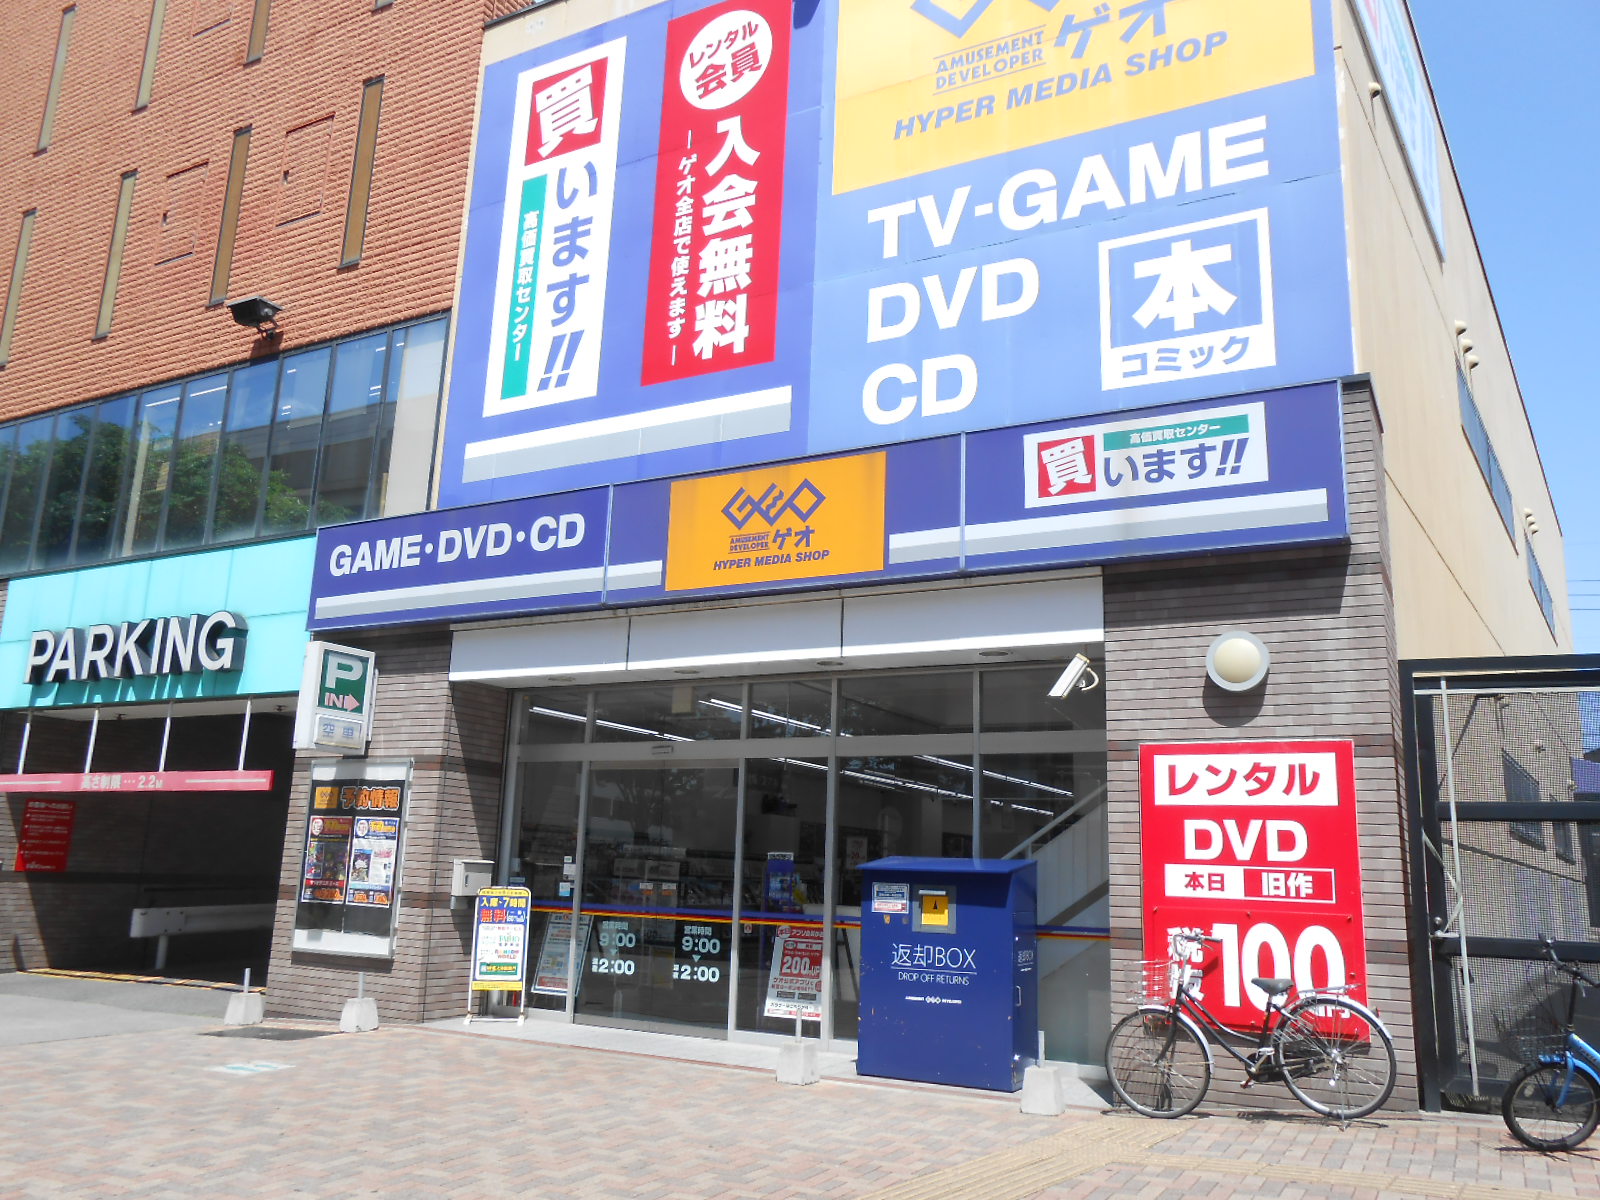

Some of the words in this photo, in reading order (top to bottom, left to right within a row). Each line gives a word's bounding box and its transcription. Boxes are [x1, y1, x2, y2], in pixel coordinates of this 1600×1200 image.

[687, 20, 760, 68] レンタル
[1053, 0, 1172, 59] ゲオ
[694, 42, 764, 101] 会員
[935, 29, 1046, 74] AMUSEMENT
[935, 48, 1044, 90] DEVELOPER
[893, 94, 996, 141] HYPER
[1006, 61, 1113, 111] MEDIA
[1124, 30, 1228, 77] SHOP
[867, 115, 1270, 260] TV-GAME
[667, 152, 698, 340] ゲオ全店で使えます
[692, 115, 762, 361] 入会無料
[511, 209, 541, 362] 高価買取センター
[866, 256, 1040, 344] DVD
[1132, 239, 1237, 332] 本
[1121, 335, 1251, 379] コミック
[861, 353, 978, 426] CD
[1129, 423, 1222, 445] 高価買取センター
[729, 532, 770, 545] AMUSEMENT
[729, 540, 770, 552] DEVELOPER
[772, 525, 816, 551] ゲオ
[713, 556, 752, 571] HYPER
[754, 553, 793, 568] MEDIA
[795, 549, 831, 563] SHOP
[23, 610, 246, 685] PARKING
[324, 655, 364, 690] P
[324, 692, 344, 709] IN
[1167, 761, 1321, 797] レンタル
[1183, 819, 1308, 862] DVD
[1184, 872, 1225, 892] 本日
[1261, 872, 1313, 898] 旧作
[599, 932, 636, 948] 9:00
[681, 936, 721, 954] 9:00
[890, 943, 977, 969] 返却BOX
[898, 971, 919, 983] DROP
[920, 972, 935, 984] OFF
[935, 974, 970, 986] RETURNS
